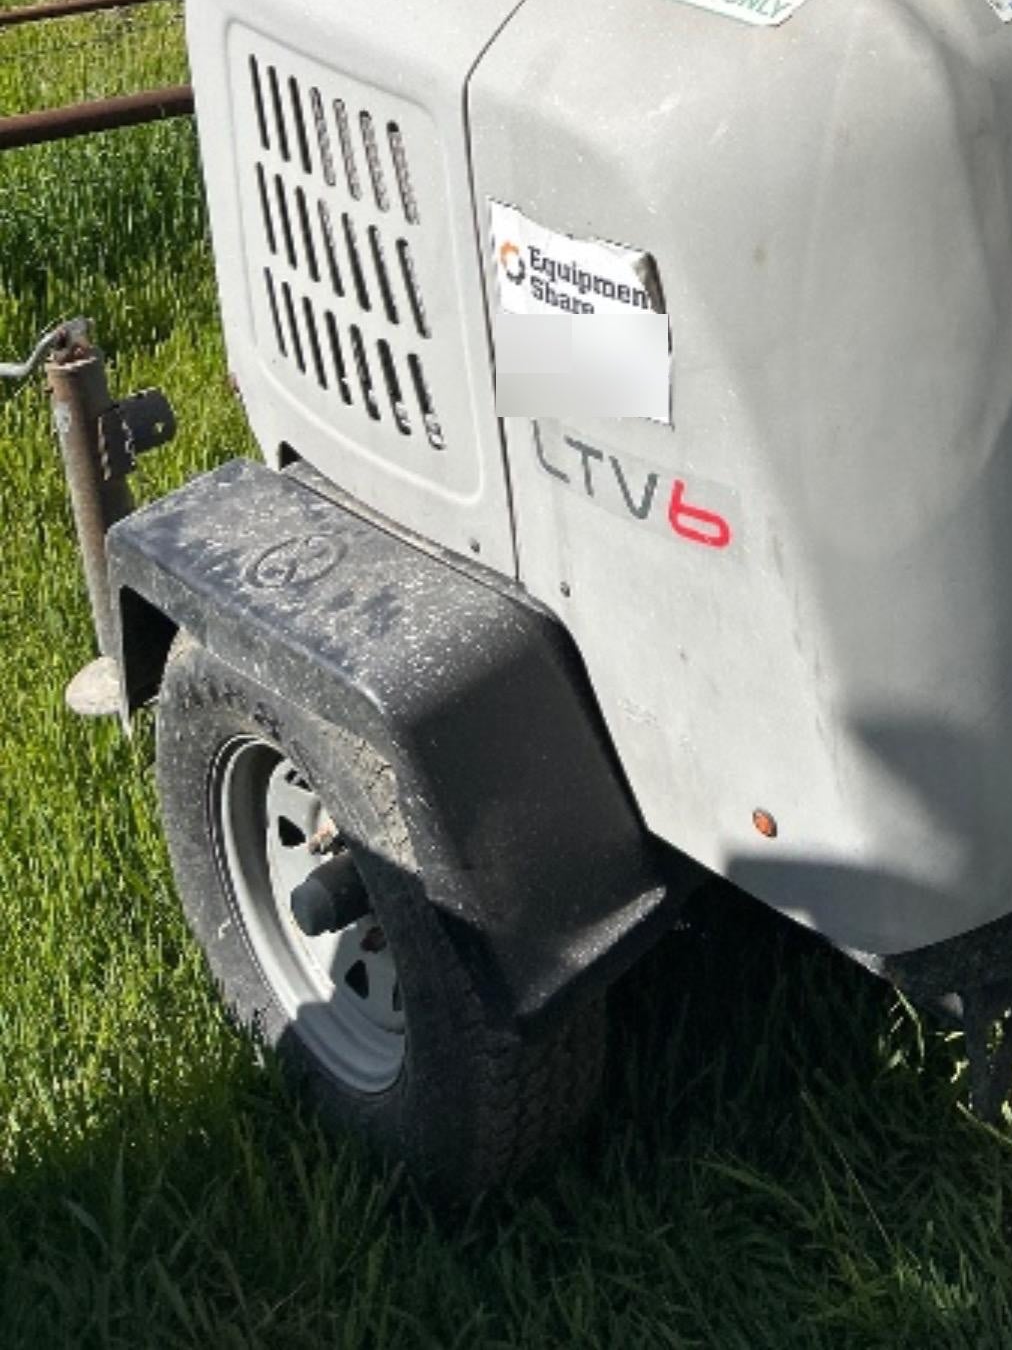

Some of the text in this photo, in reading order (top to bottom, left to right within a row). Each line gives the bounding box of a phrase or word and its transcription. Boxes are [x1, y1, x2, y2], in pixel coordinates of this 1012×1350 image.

[527, 244, 651, 311] Equipmen
[530, 275, 595, 314] Share
[531, 418, 731, 549] LTV6
